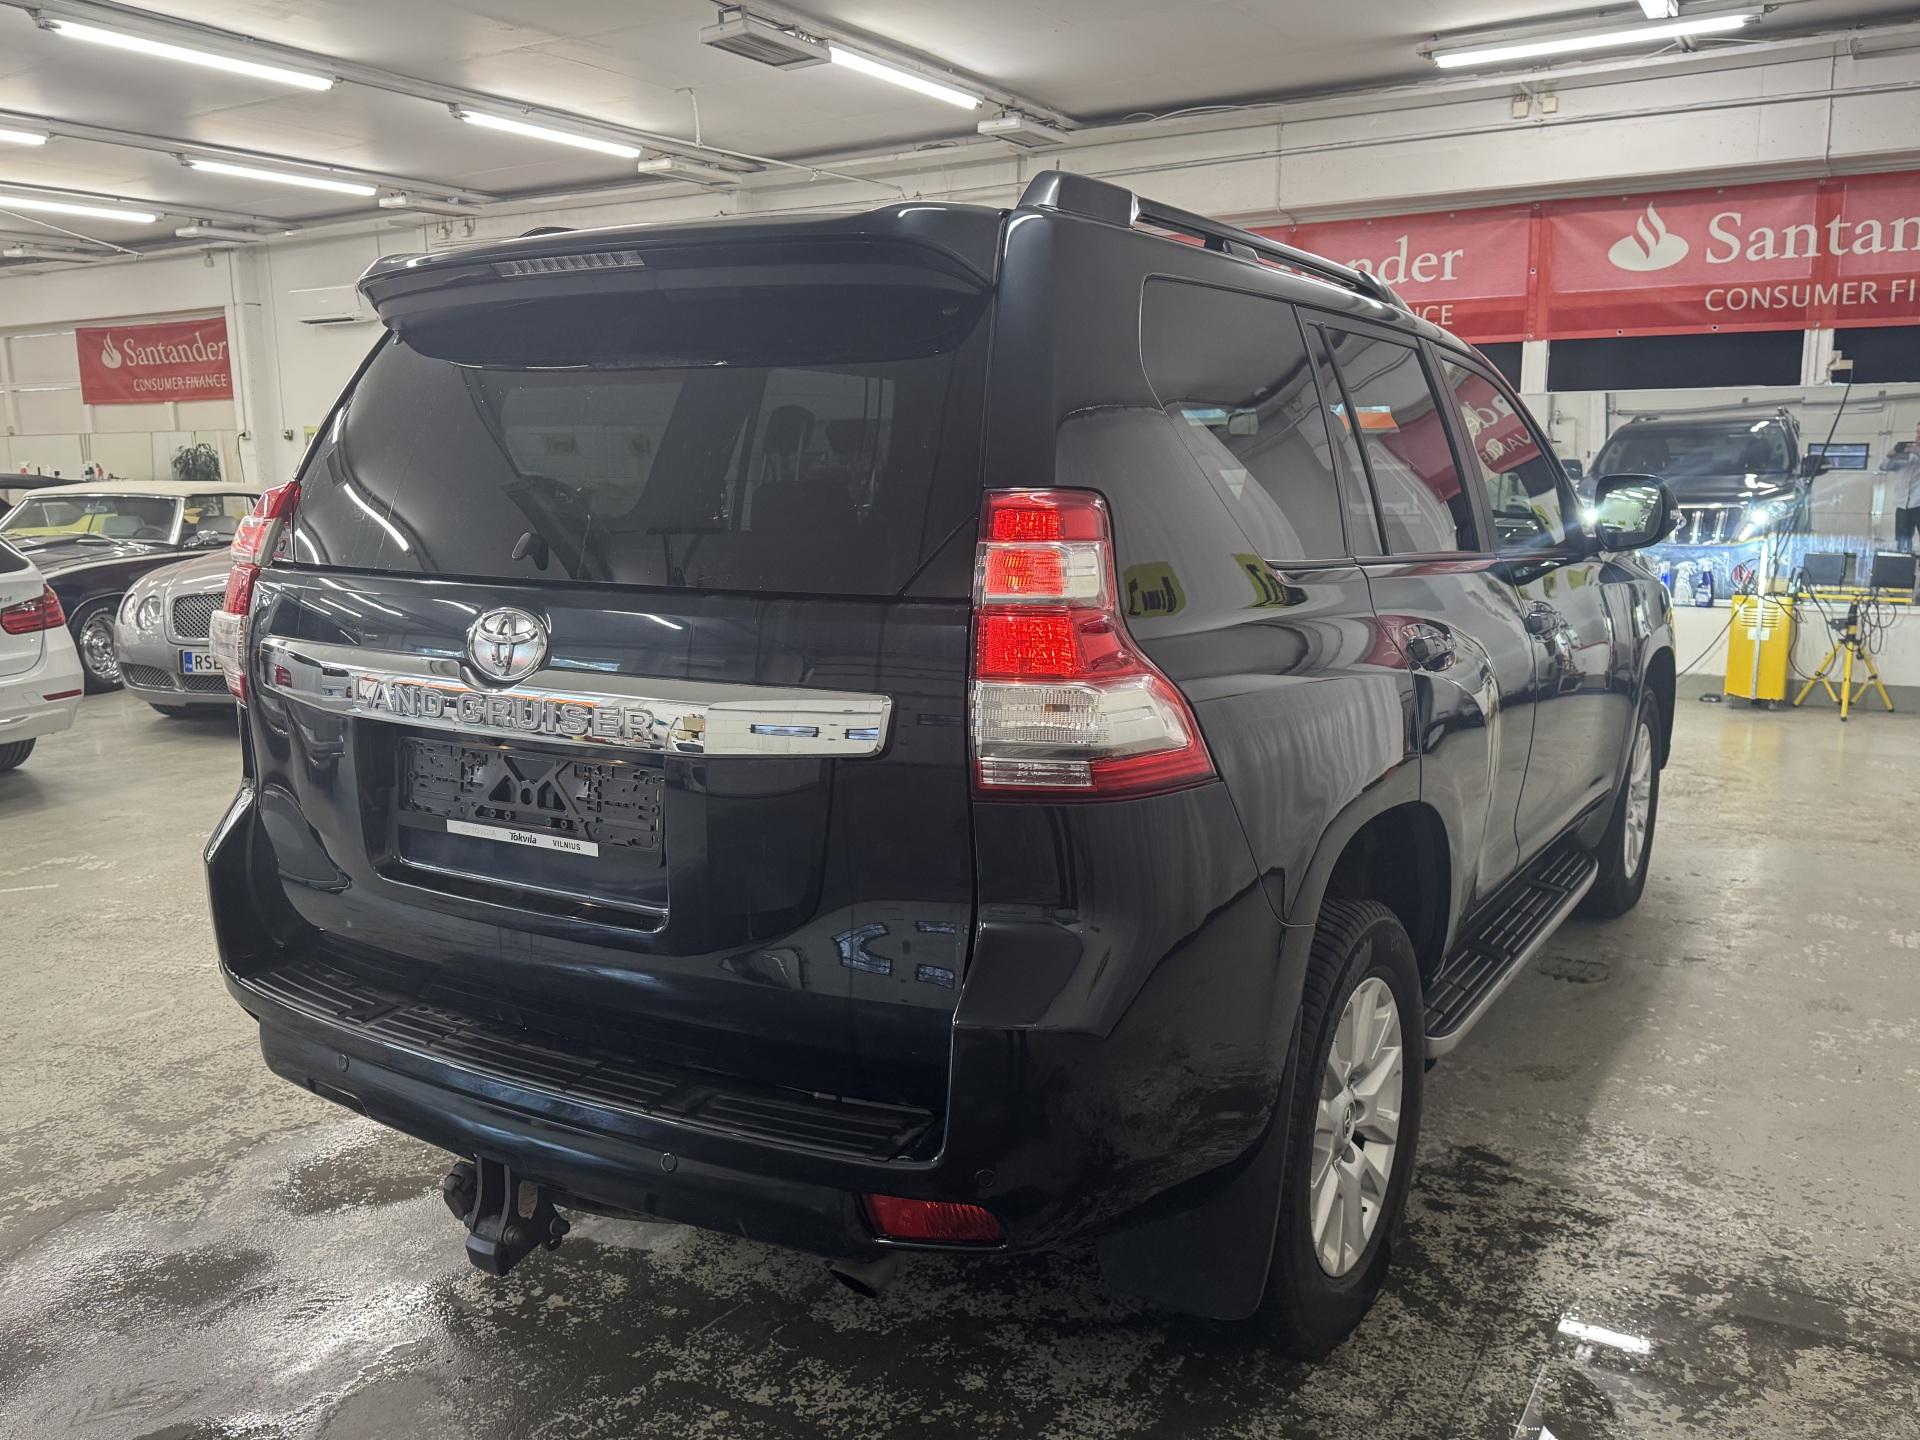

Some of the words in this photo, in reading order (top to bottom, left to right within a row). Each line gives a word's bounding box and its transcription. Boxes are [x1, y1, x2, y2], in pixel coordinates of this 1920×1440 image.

[1705, 212, 1920, 264] Santan
[1705, 281, 1878, 312] CONSUMER
[1415, 304, 1454, 325] CE
[123, 331, 227, 367] Santander
[133, 377, 185, 392] CONSUMER
[352, 676, 444, 719] LAND
[456, 692, 655, 743] CRUISER
[509, 831, 537, 845] Tokvila
[552, 839, 581, 851] VILNIUS
